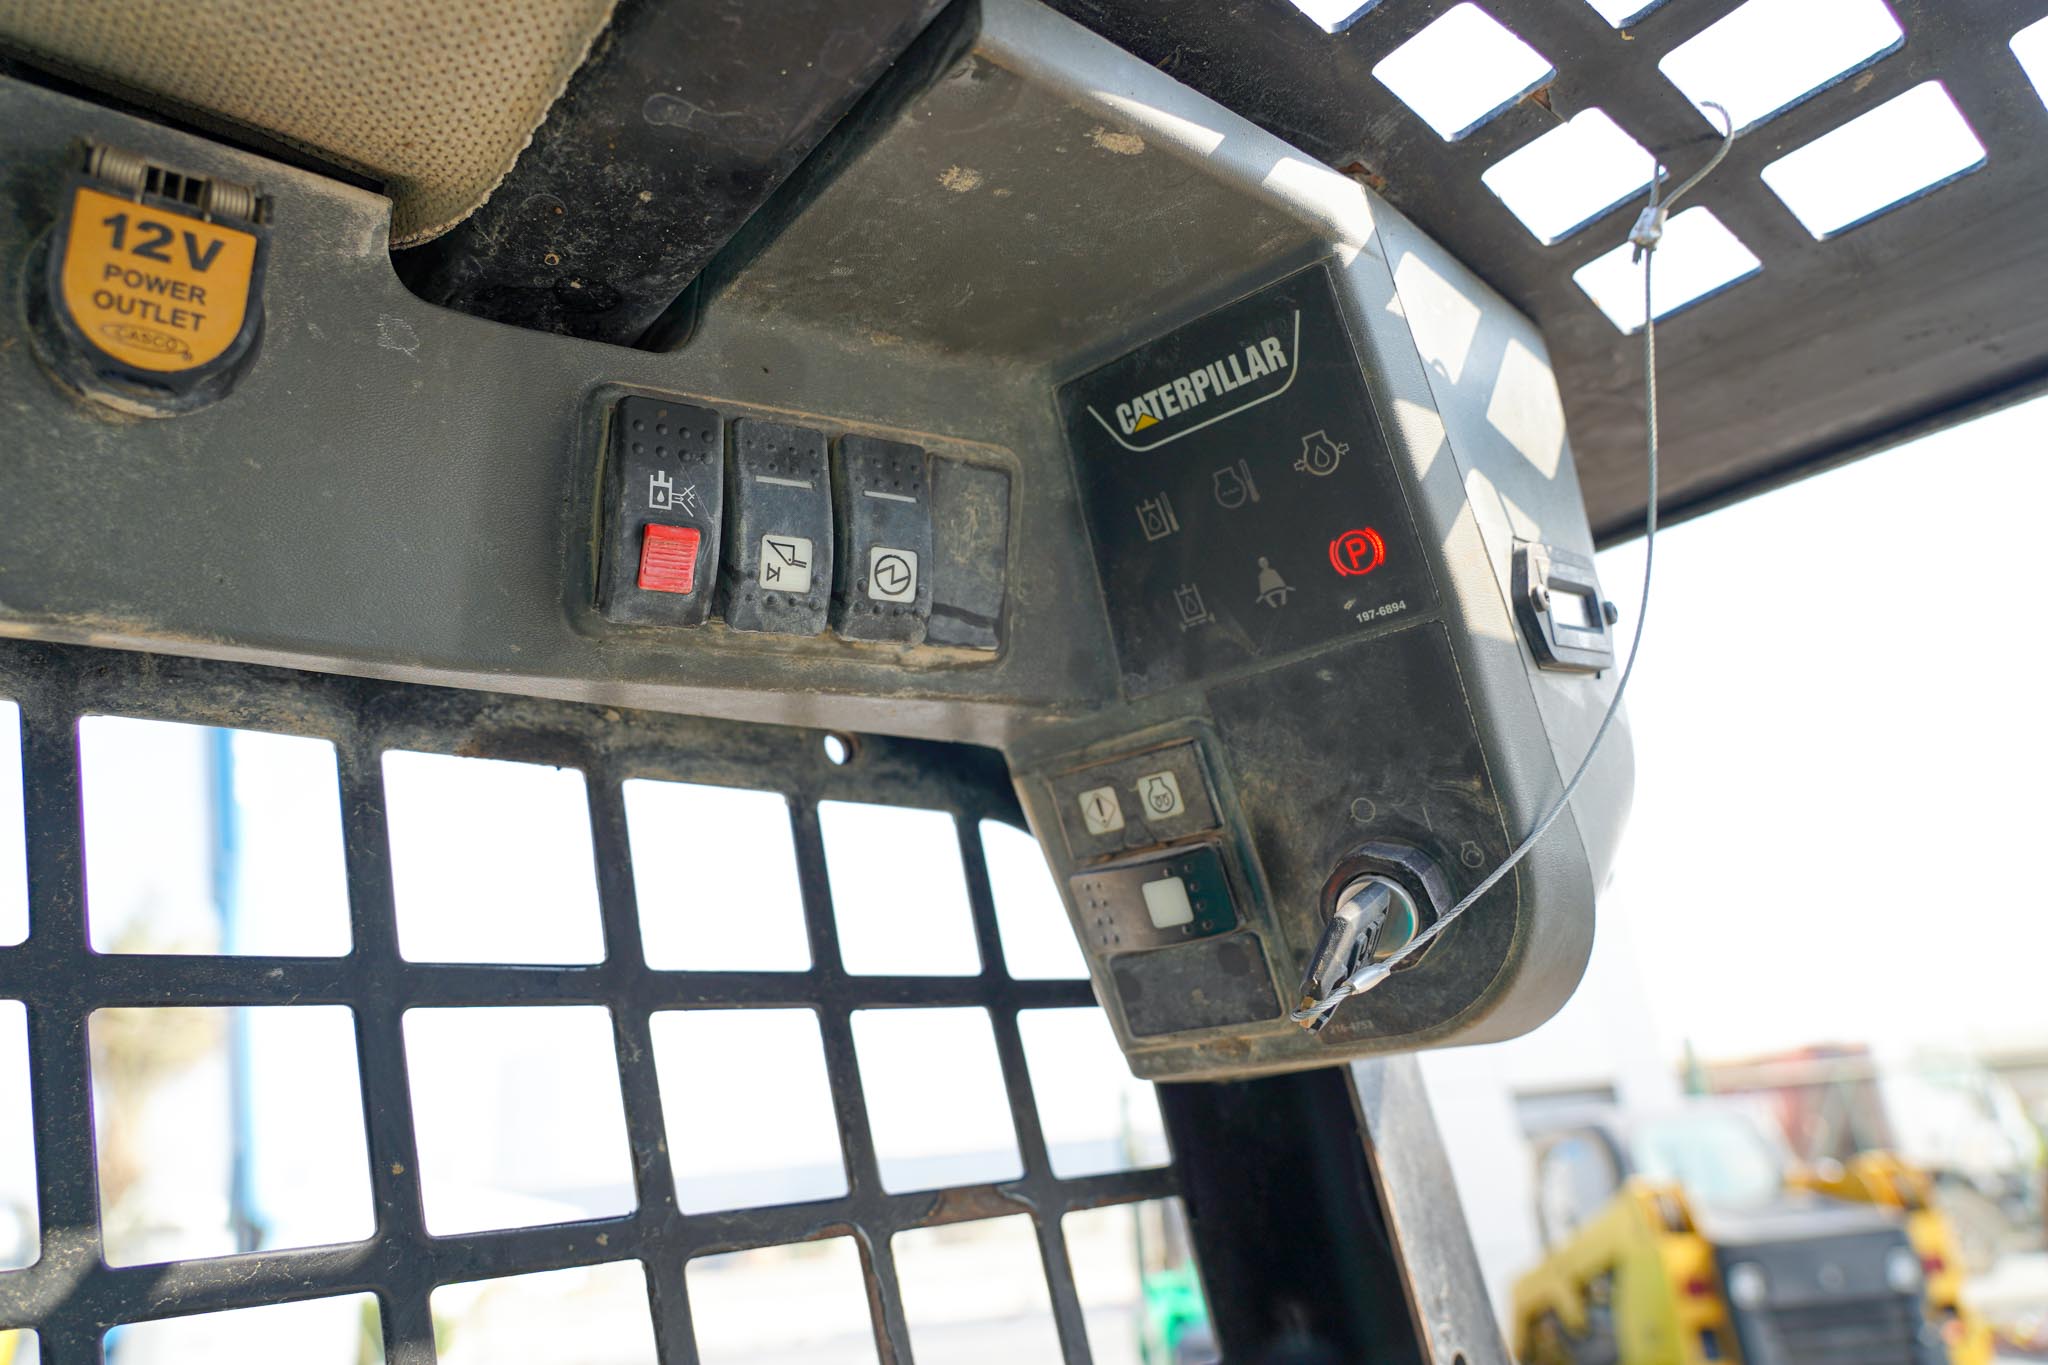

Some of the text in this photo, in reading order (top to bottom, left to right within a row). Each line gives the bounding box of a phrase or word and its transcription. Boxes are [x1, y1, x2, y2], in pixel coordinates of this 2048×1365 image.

[102, 212, 225, 272] 12V
[104, 262, 207, 306] POWER
[92, 289, 206, 332] OUTLET
[1115, 336, 1288, 435] CATERPILLAR
[1344, 537, 1367, 569] P
[1356, 600, 1406, 623] 197-6894
